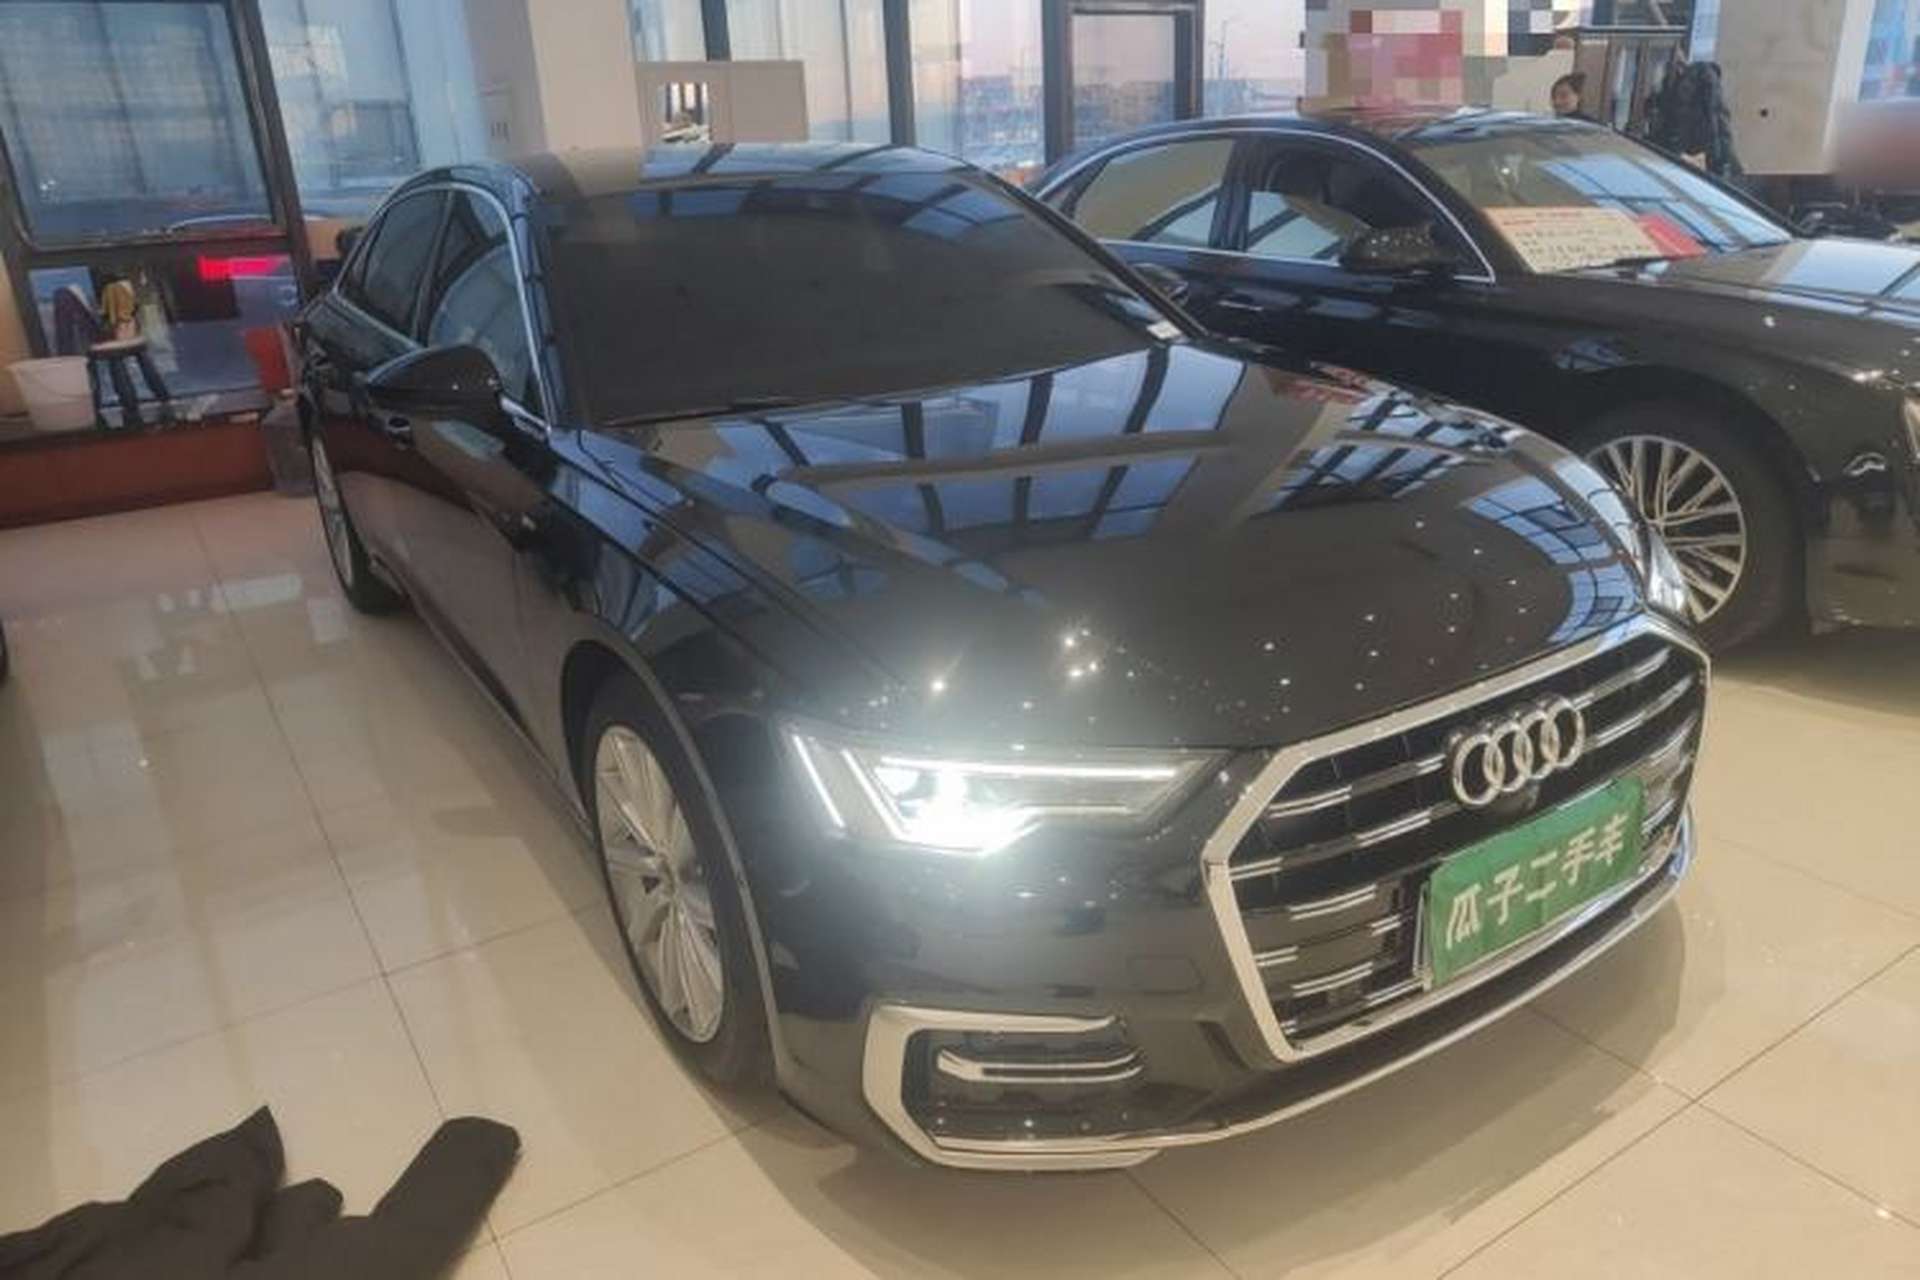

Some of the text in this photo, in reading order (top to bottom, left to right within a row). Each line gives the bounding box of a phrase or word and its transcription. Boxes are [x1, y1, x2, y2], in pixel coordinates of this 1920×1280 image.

[1446, 813, 1629, 949] 瓜子二手车
